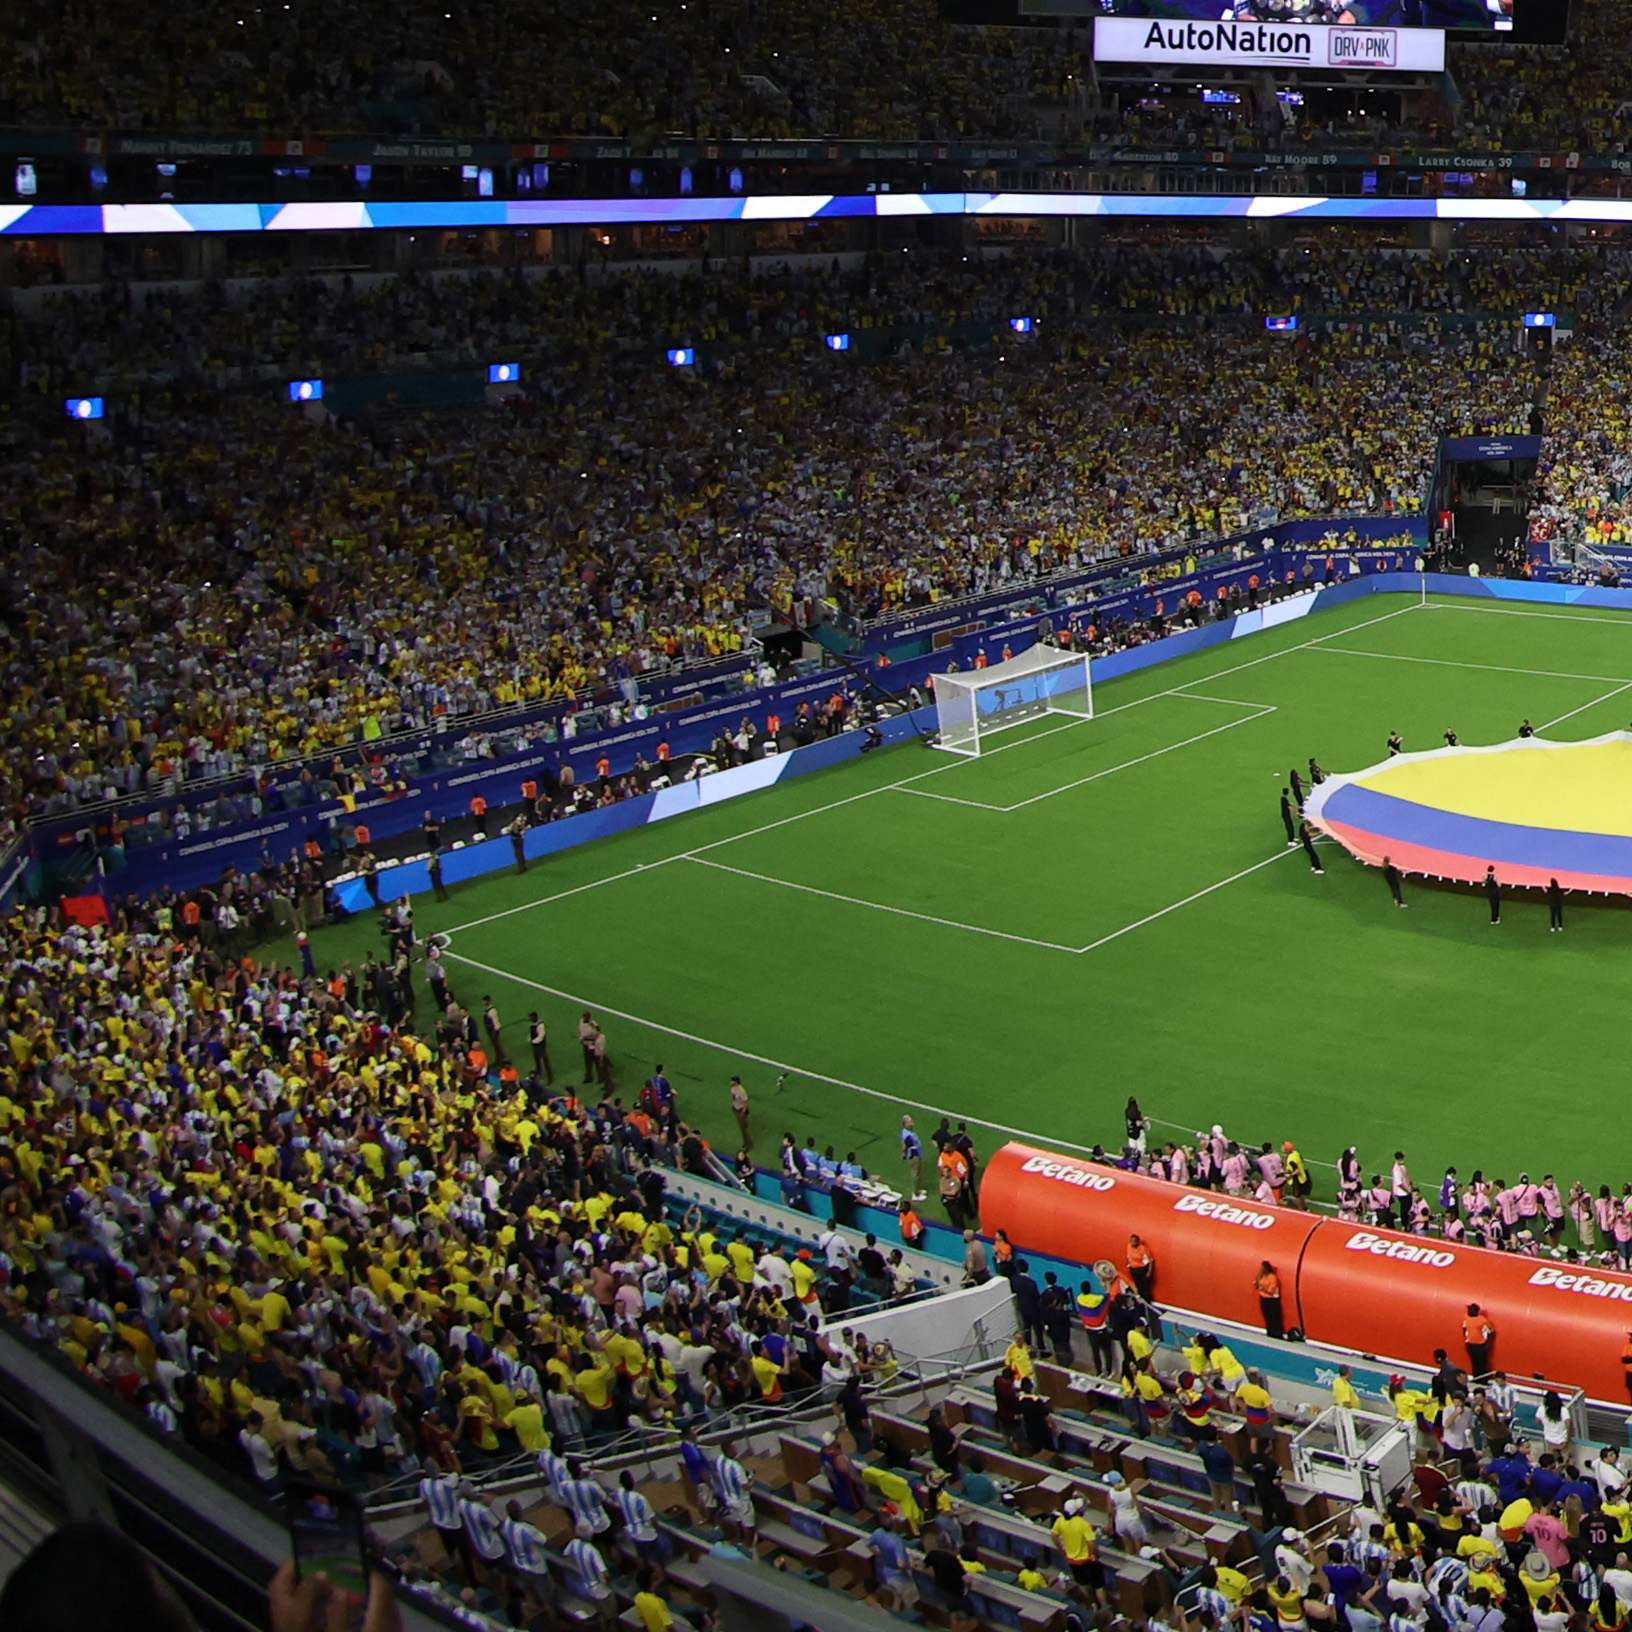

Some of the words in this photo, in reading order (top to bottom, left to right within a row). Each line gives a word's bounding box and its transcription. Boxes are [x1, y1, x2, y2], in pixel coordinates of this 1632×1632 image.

[1144, 21, 1311, 53] AutoNation
[1335, 37, 1359, 56] DRV
[1366, 38, 1390, 58] PNK
[1419, 157, 1450, 167] LARRY
[1453, 157, 1494, 168] CSONKA
[1498, 157, 1513, 168] 39
[1021, 1156, 1116, 1192] Betano
[1174, 1194, 1275, 1230] Betano
[1345, 1231, 1456, 1268] Betano
[1589, 1528, 1608, 1544] 10
